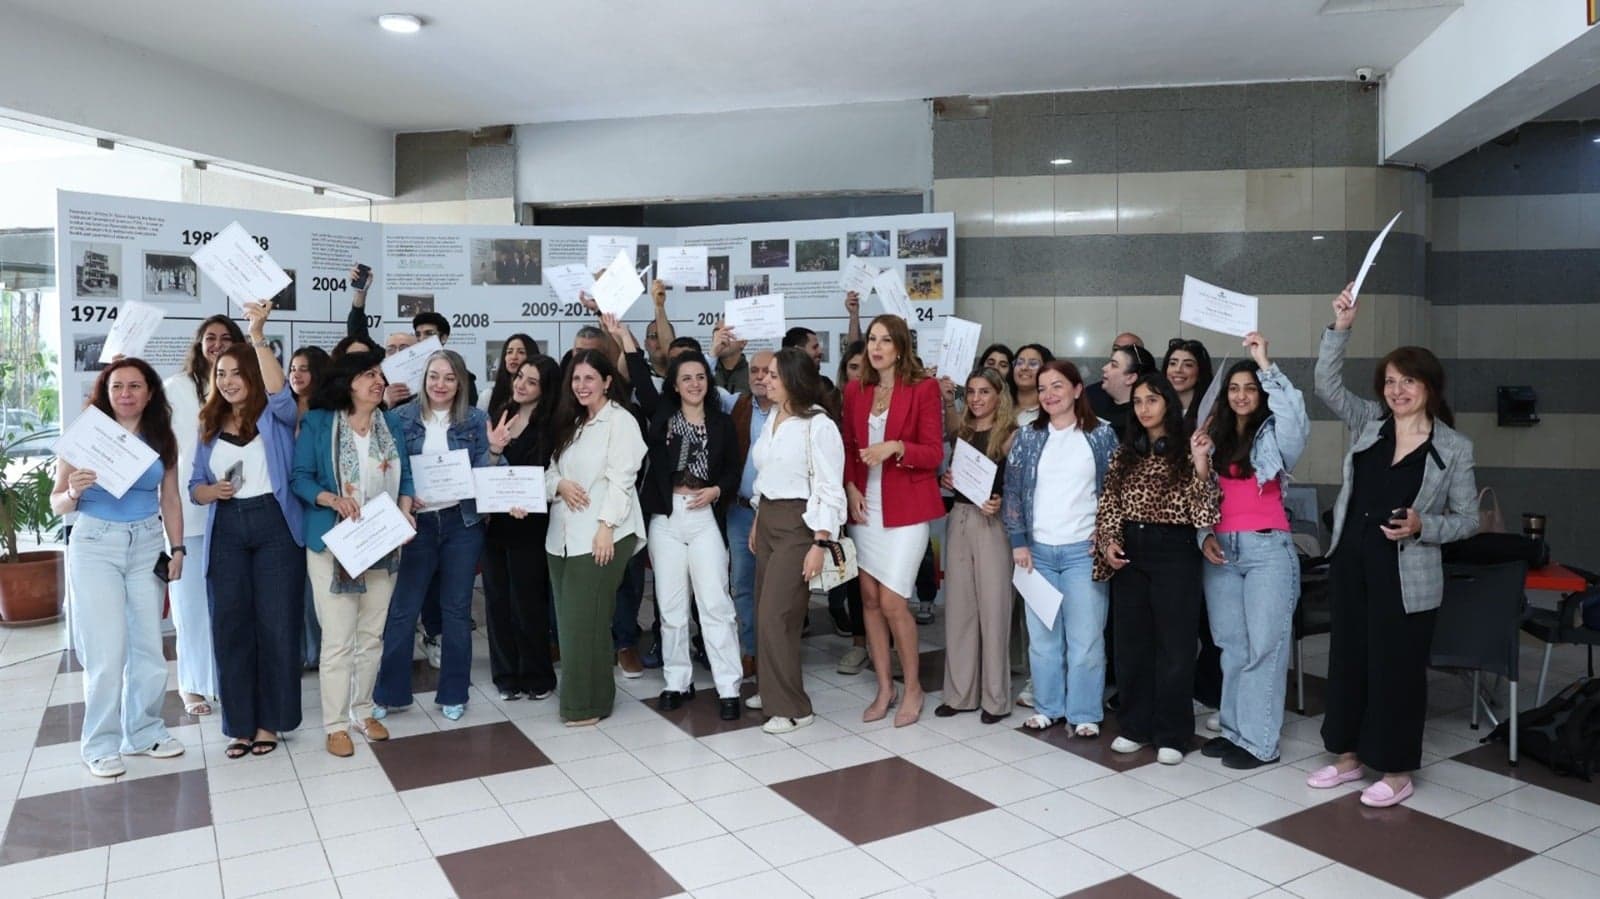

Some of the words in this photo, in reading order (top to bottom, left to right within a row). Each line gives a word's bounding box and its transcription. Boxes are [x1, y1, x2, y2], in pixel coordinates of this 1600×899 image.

[312, 277, 347, 292] 2004
[71, 305, 118, 323] 1974
[521, 302, 598, 317] 2009-201
[452, 313, 490, 328] 2008
[697, 311, 725, 326] 201
